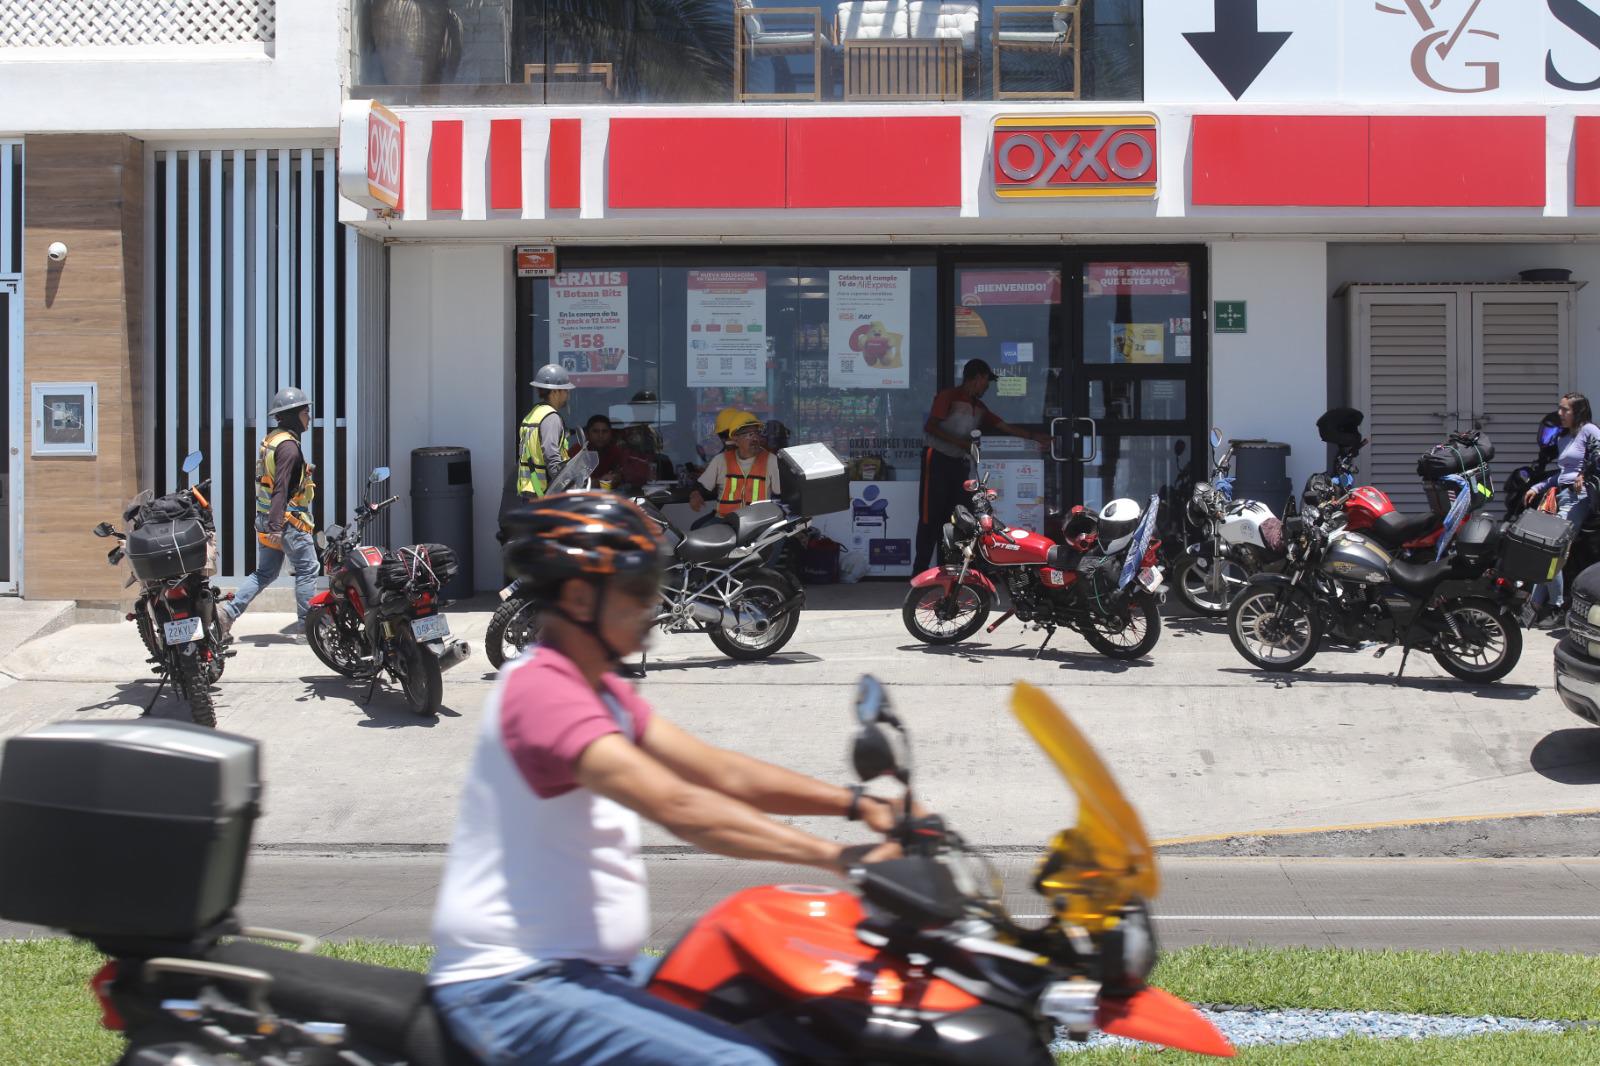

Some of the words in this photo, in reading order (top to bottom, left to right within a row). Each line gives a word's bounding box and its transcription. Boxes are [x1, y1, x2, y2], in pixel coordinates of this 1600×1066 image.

[371, 122, 399, 186] OXXO
[998, 129, 1153, 186] OXXO
[1126, 268, 1170, 276] ENCANTA
[555, 272, 621, 286] GRATIS
[1100, 278, 1120, 286] QUE
[563, 290, 599, 298] Botana
[602, 289, 622, 297] Bitz
[974, 283, 1047, 294] ¡BIENVENIDO!
[563, 333, 605, 349] $158
